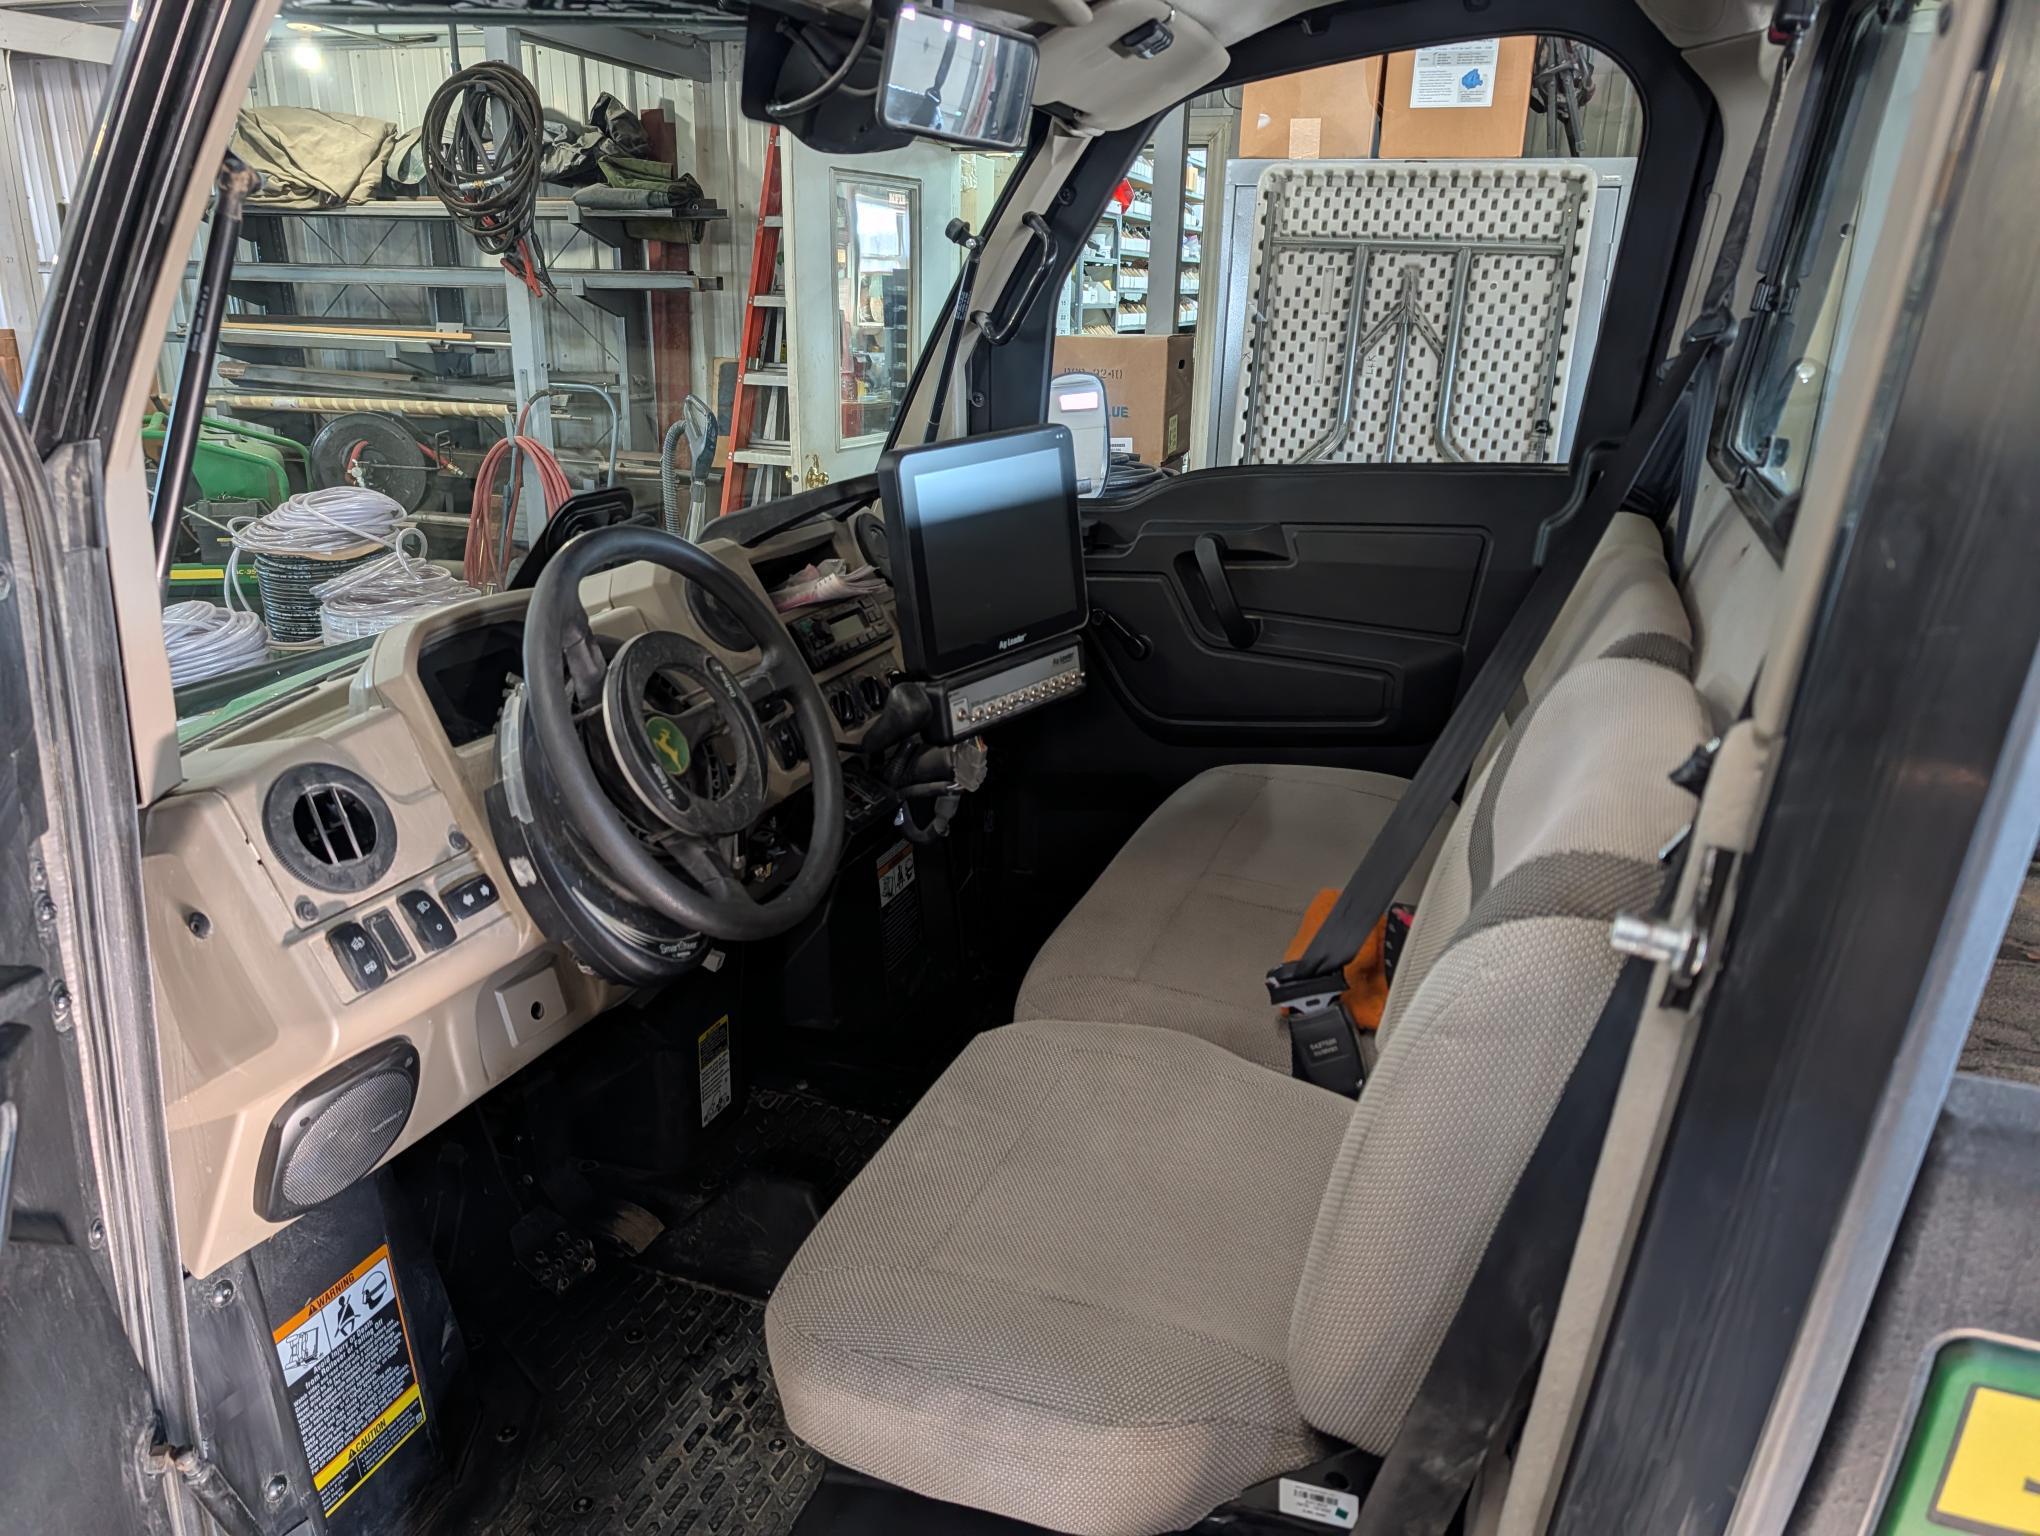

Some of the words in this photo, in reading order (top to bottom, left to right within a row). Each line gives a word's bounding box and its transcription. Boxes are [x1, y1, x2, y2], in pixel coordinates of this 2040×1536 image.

[1109, 406, 1129, 418] UE
[316, 1271, 354, 1309] WARNING
[305, 1372, 320, 1390] from
[320, 1350, 346, 1376] Rollover
[346, 1343, 353, 1355] or
[354, 1326, 374, 1348] Falling
[374, 1318, 383, 1331] Off
[312, 1355, 330, 1374] Avoid
[330, 1340, 347, 1359] Injury
[348, 1333, 356, 1344] or
[356, 1318, 373, 1337] Death
[355, 1417, 386, 1452] CAUTION
